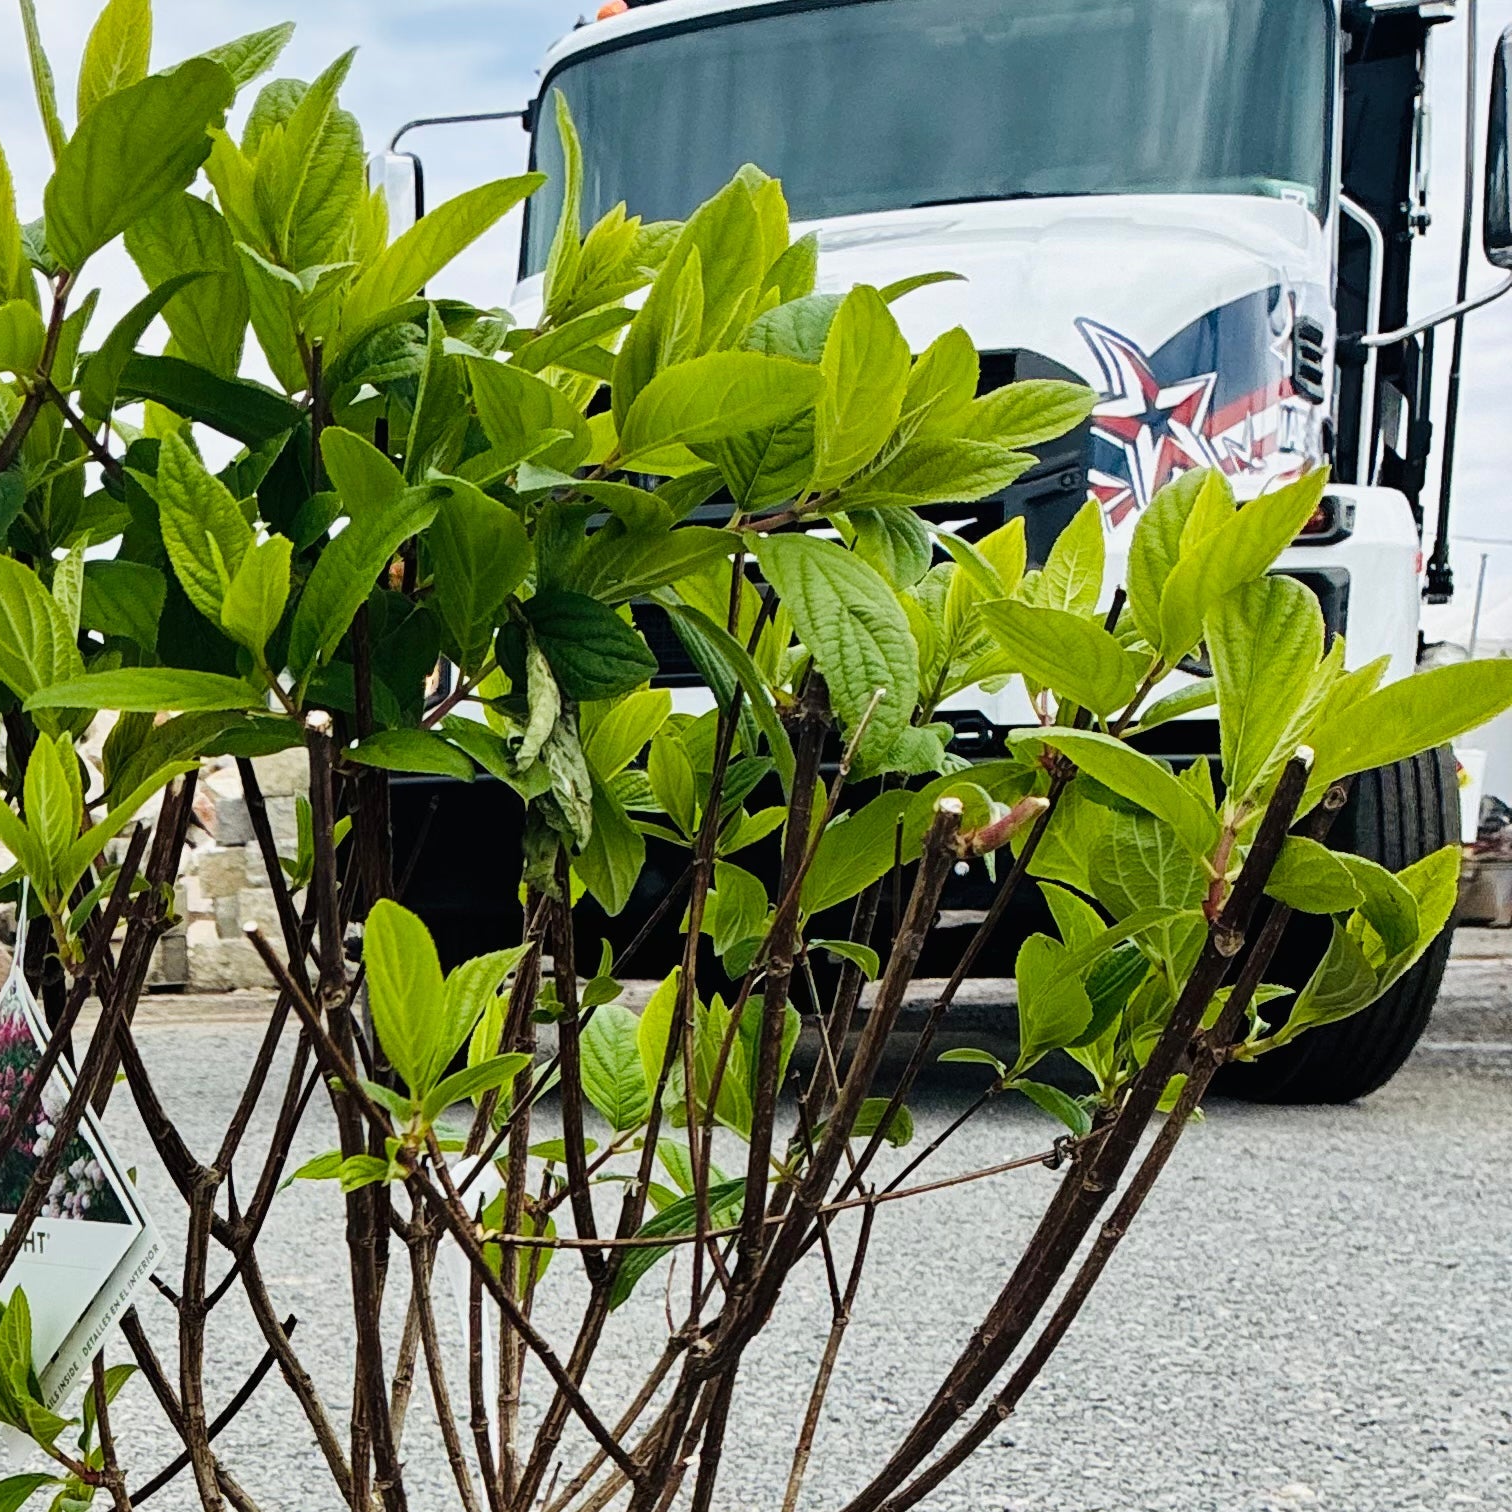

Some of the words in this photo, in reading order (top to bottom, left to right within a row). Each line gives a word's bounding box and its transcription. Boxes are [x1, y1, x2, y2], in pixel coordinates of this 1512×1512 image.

[46, 1391, 60, 1411] AILS
[58, 1361, 80, 1396] INSIDE
[82, 1312, 112, 1358] DETALLES
[110, 1301, 121, 1315] EN
[118, 1288, 130, 1301] EL
[127, 1243, 160, 1291] INTERIOR
